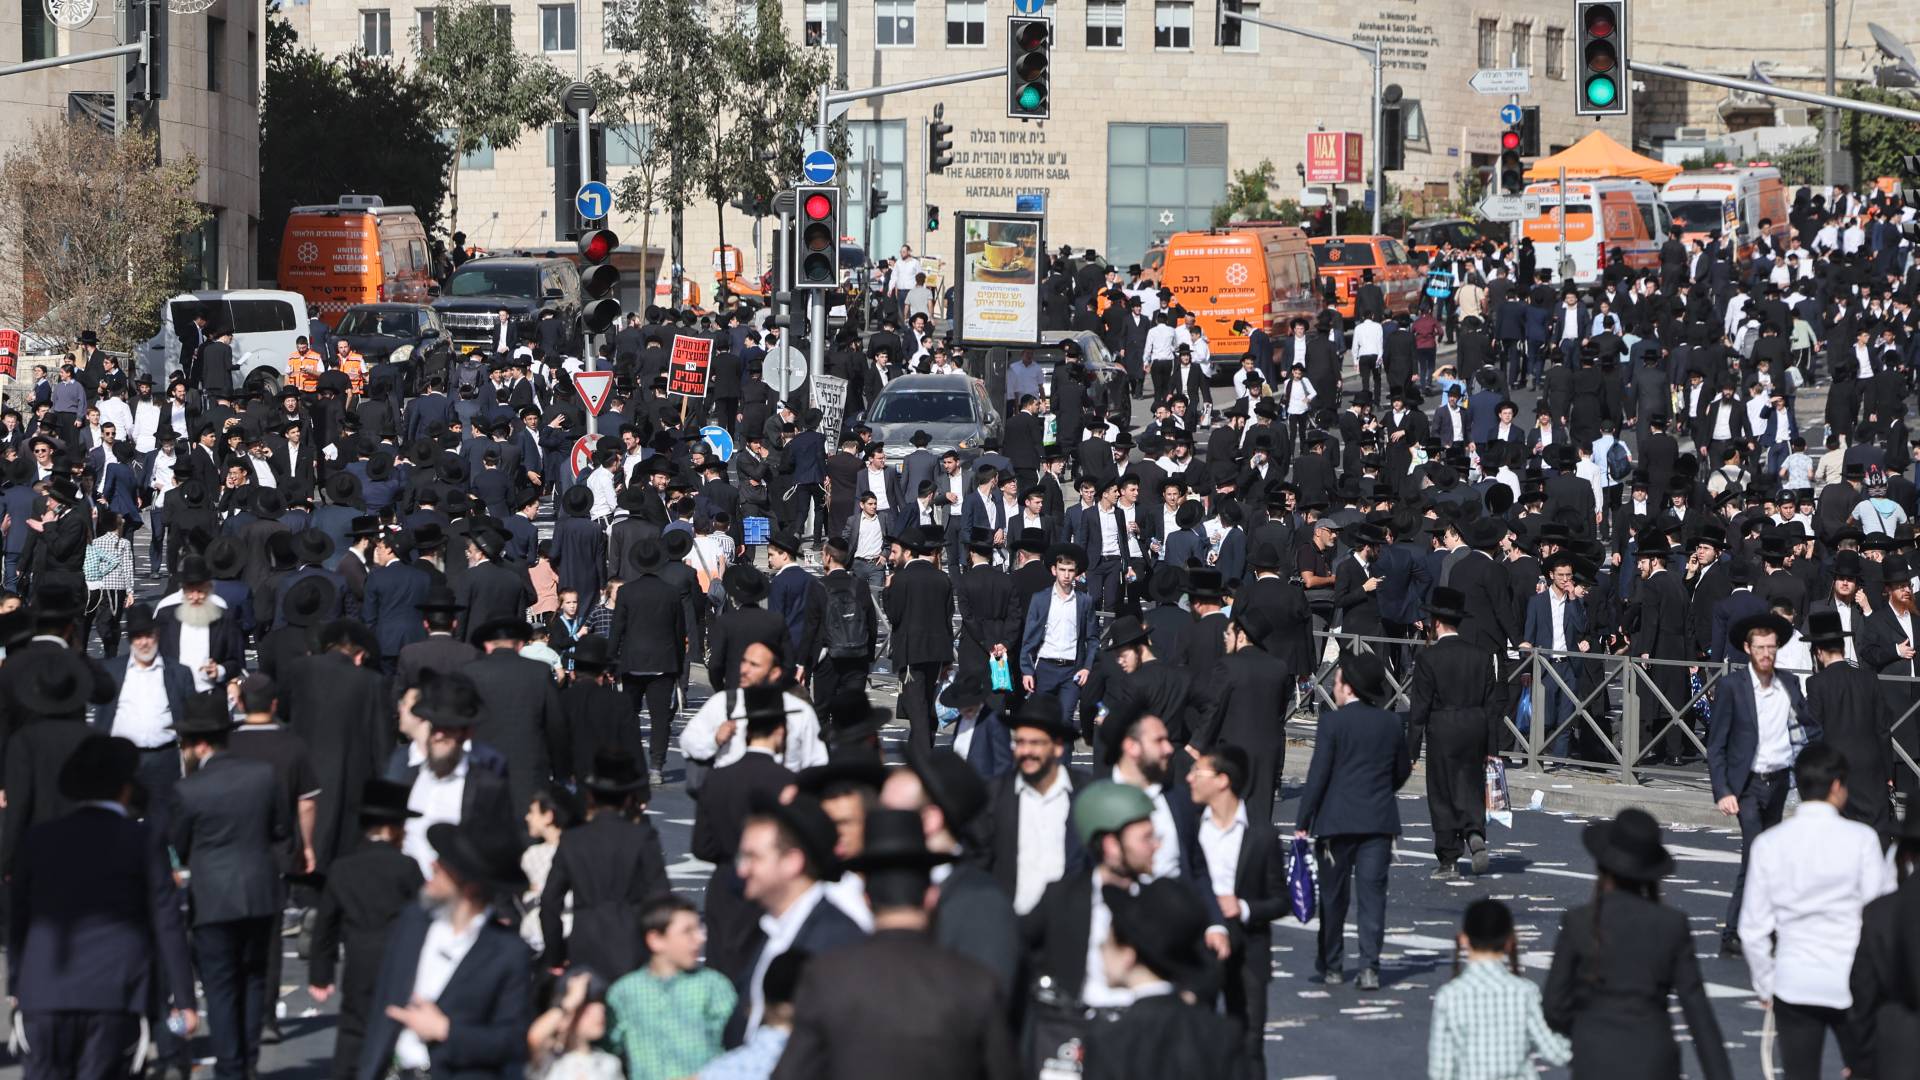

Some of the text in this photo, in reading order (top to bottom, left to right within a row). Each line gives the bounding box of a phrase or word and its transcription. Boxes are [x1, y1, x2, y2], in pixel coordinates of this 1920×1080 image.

[1387, 12, 1410, 22] Memory
[1411, 13, 1416, 21] of
[1359, 22, 1385, 30] Abraham
[1392, 24, 1405, 32] Sara
[1352, 33, 1375, 41] Shlomo
[970, 128, 1046, 144] בית איחוד הצלה
[972, 151, 1006, 165] ויהודית
[1010, 149, 1045, 165] אלברטו
[1048, 151, 1067, 165] ע"ש
[946, 167, 1070, 180] THE ALBERTO & JUDITH SABA
[966, 186, 1050, 198] HATZALAH CENTER
[1174, 247, 1252, 256] UNITED HATZALAH
[1182, 275, 1200, 283] רכב
[1173, 285, 1208, 294] מבצעים
[702, 340, 709, 352] לא
[675, 370, 703, 383] רועדים
